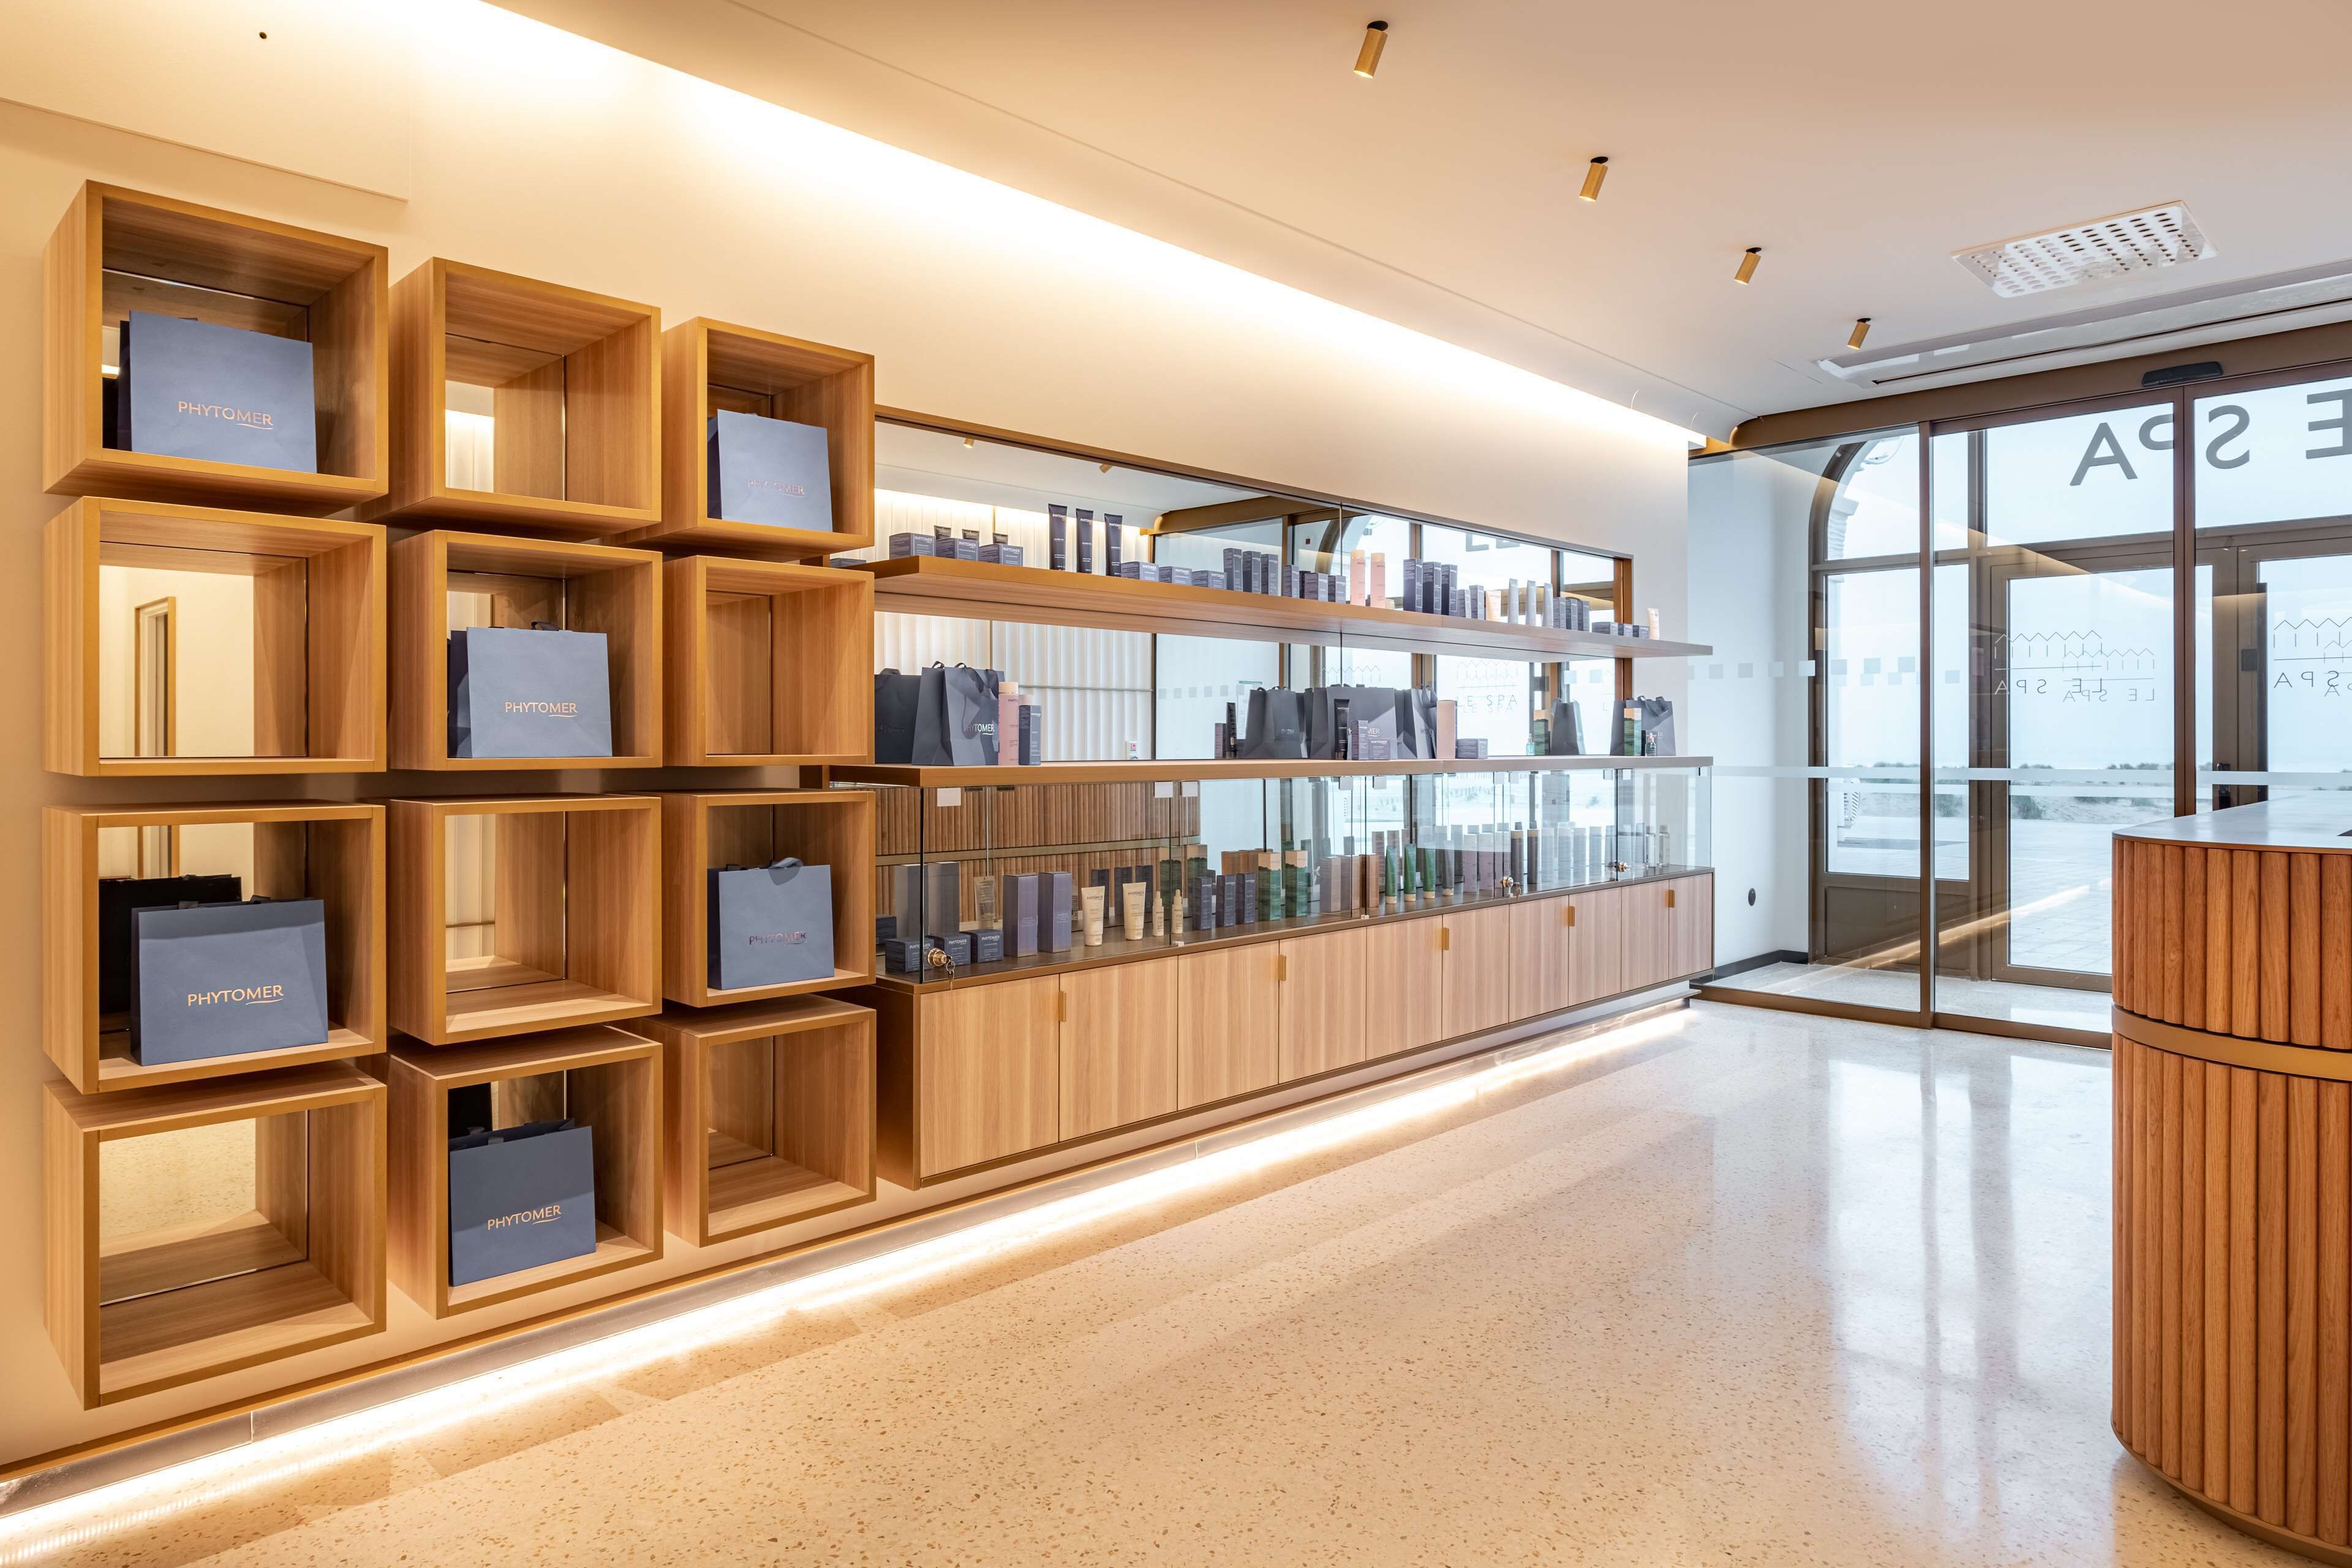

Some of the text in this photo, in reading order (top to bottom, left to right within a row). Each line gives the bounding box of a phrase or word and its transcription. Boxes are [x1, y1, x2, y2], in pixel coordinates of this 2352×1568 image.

[177, 401, 274, 426] PHYTOMER
[505, 702, 578, 714] PHYTOMER
[187, 984, 284, 1006] PHYTOMER
[488, 1205, 562, 1231] PHYTOMER
